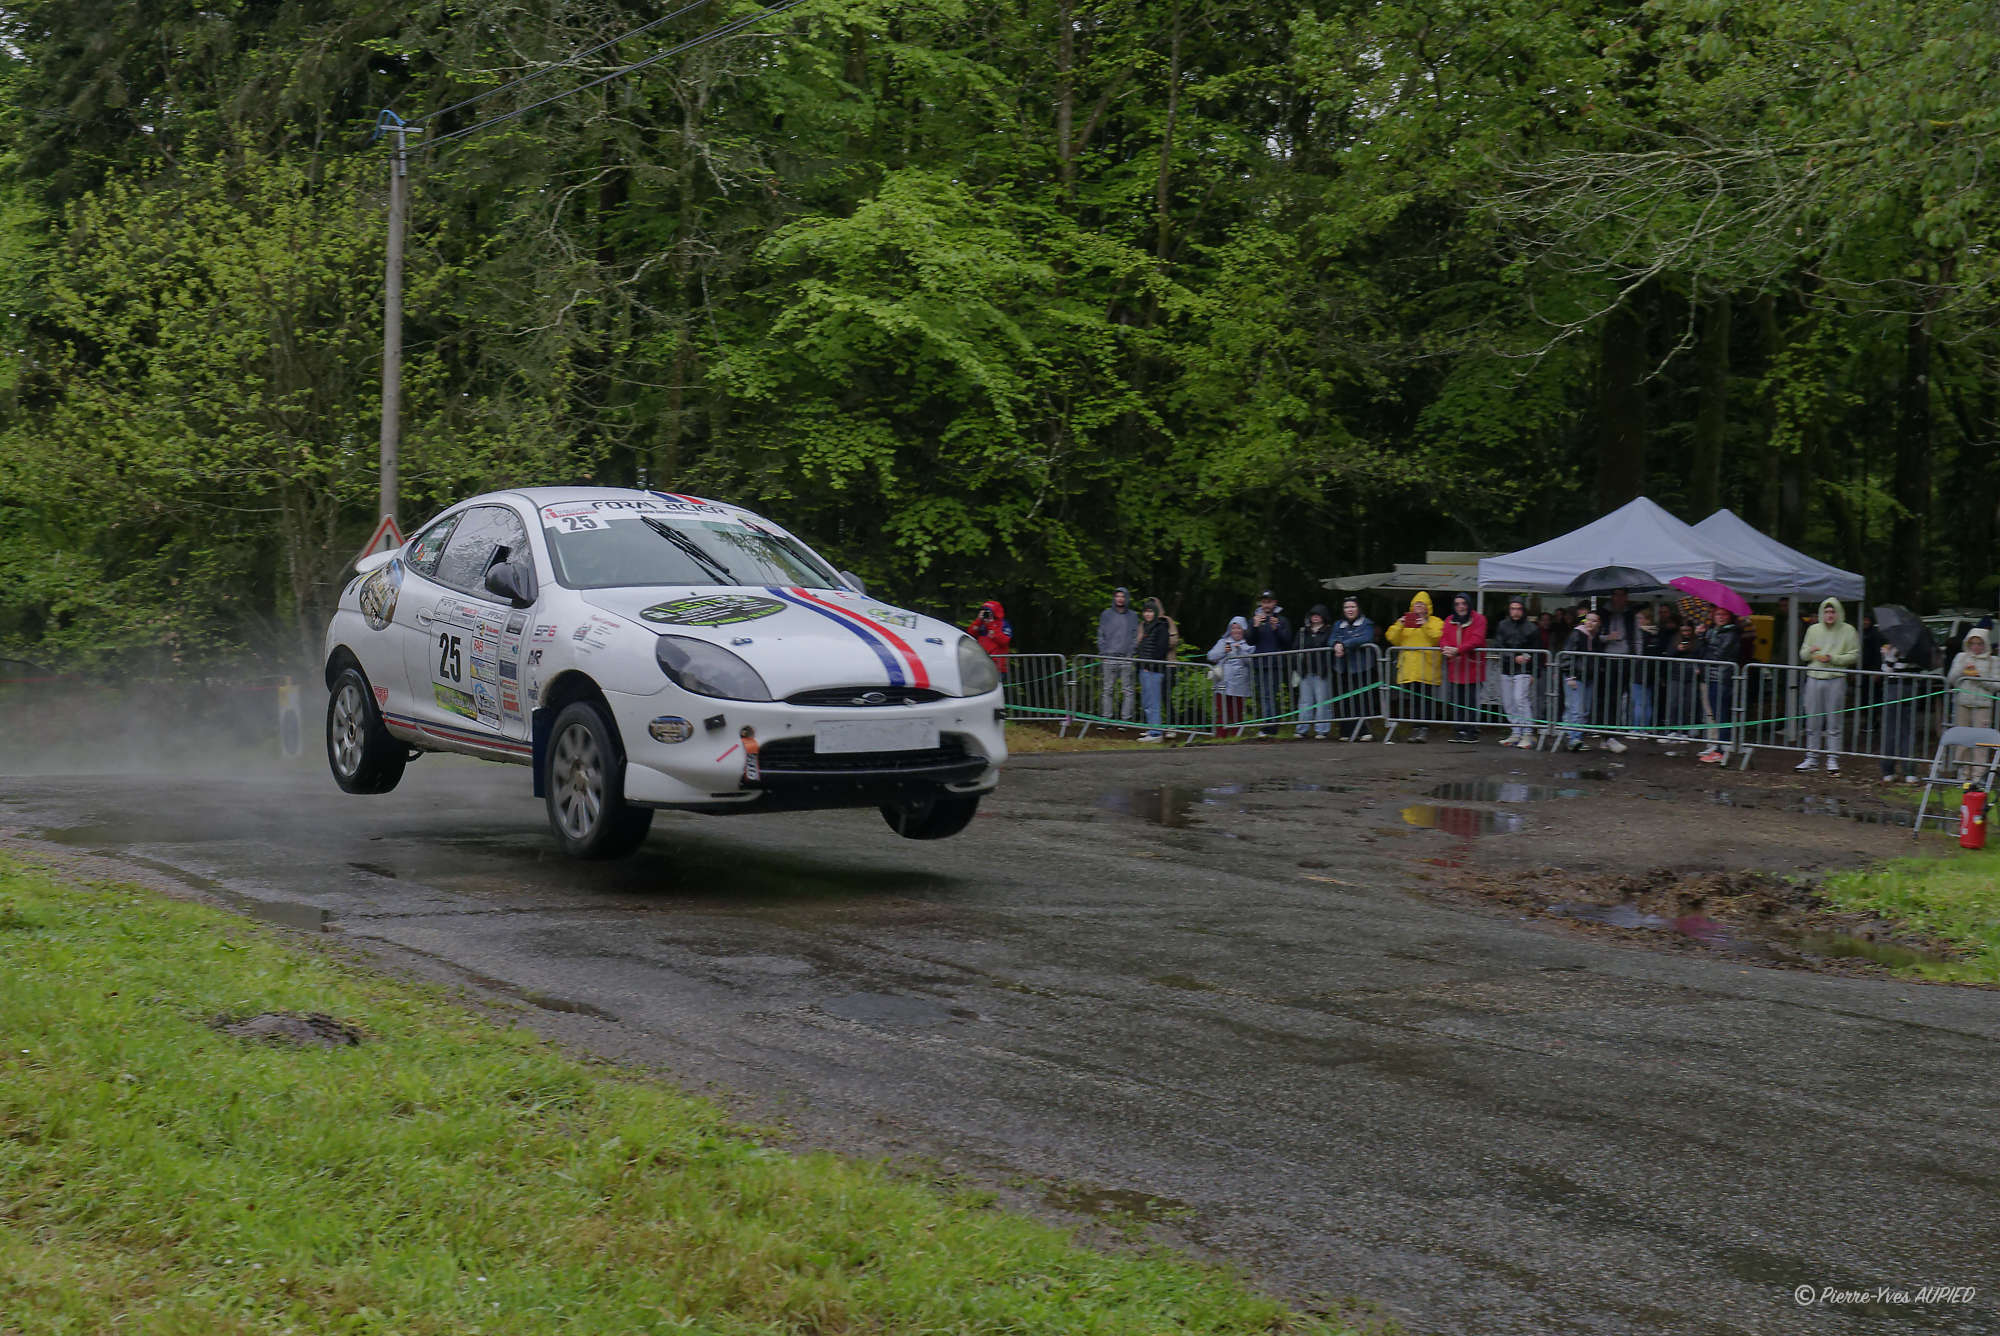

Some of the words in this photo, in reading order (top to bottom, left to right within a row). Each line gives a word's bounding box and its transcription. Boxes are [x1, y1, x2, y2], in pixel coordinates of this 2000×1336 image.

[591, 501, 657, 511] FORM
[561, 515, 599, 532] 25
[439, 632, 462, 683] 25
